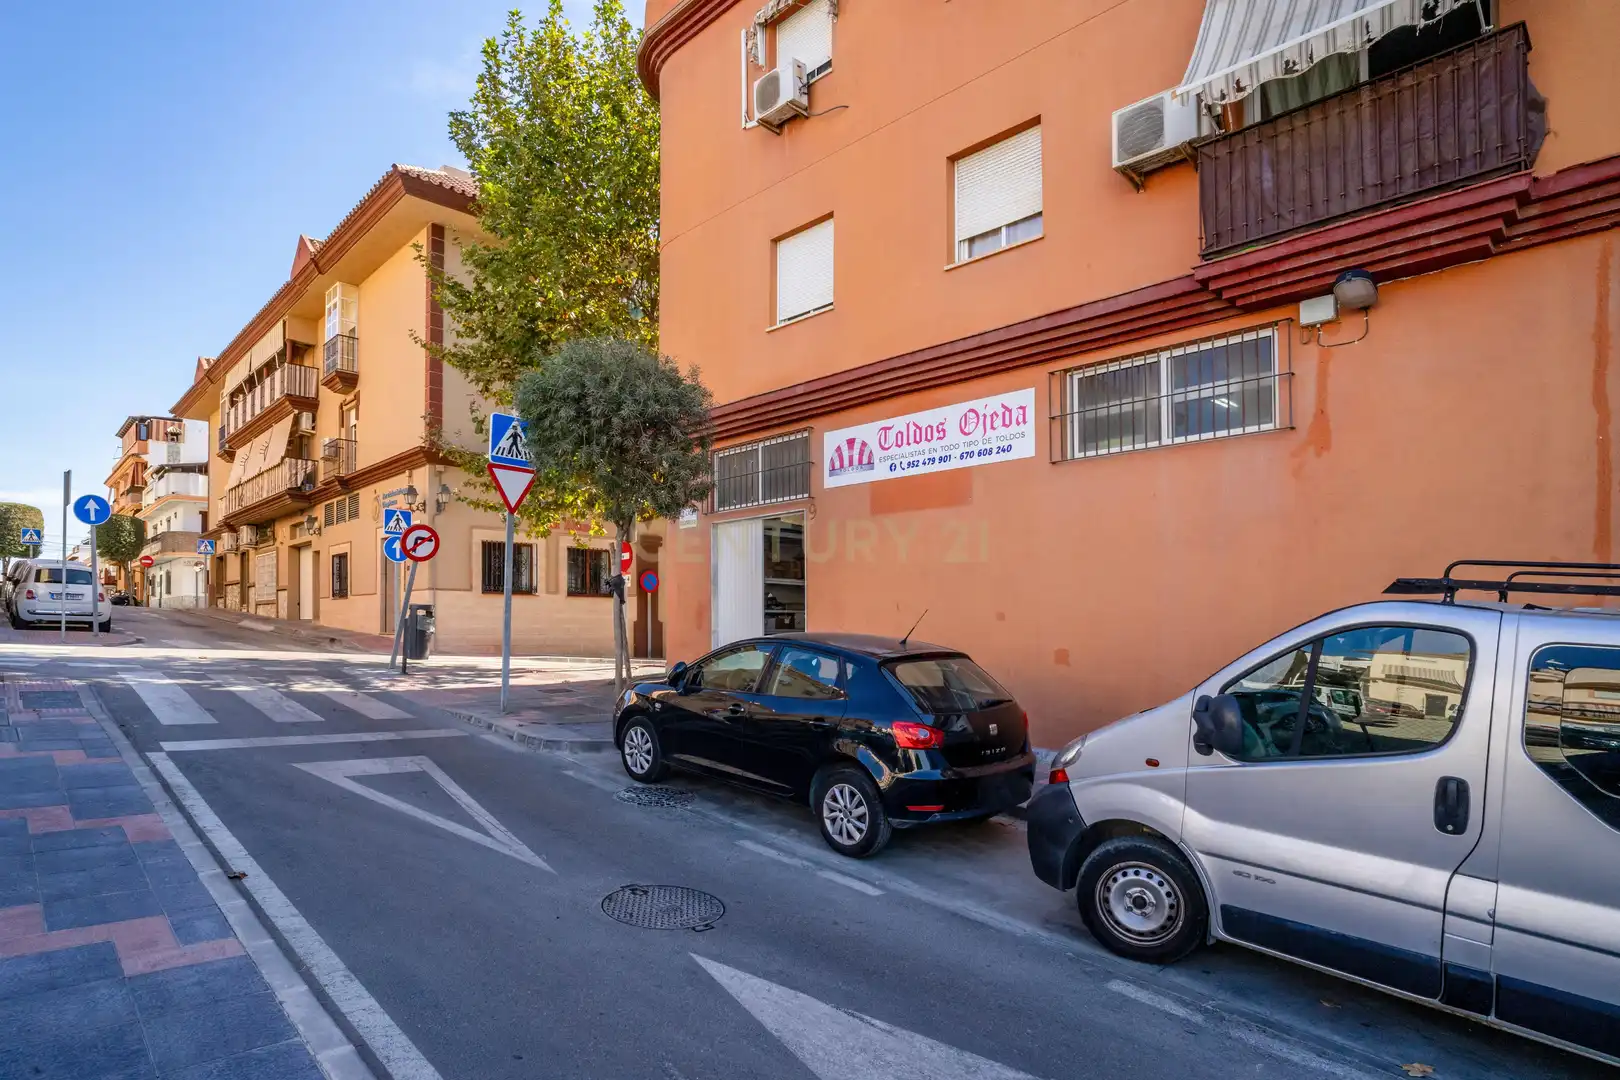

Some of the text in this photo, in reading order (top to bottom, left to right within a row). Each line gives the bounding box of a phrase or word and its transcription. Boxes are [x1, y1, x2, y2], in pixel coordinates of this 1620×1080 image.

[877, 403, 1028, 452] Toldos Ojeda
[879, 449, 926, 463] ESPECIALISTAS
[940, 443, 960, 453] TODO
[962, 439, 980, 449] TIPO
[982, 437, 993, 445] DE
[995, 431, 1026, 443] TOLDOS
[906, 460, 920, 469] 952
[921, 457, 936, 467] 479
[937, 454, 952, 465] 901
[959, 450, 975, 462] 670
[977, 447, 993, 457] 608
[996, 444, 1013, 455] 240
